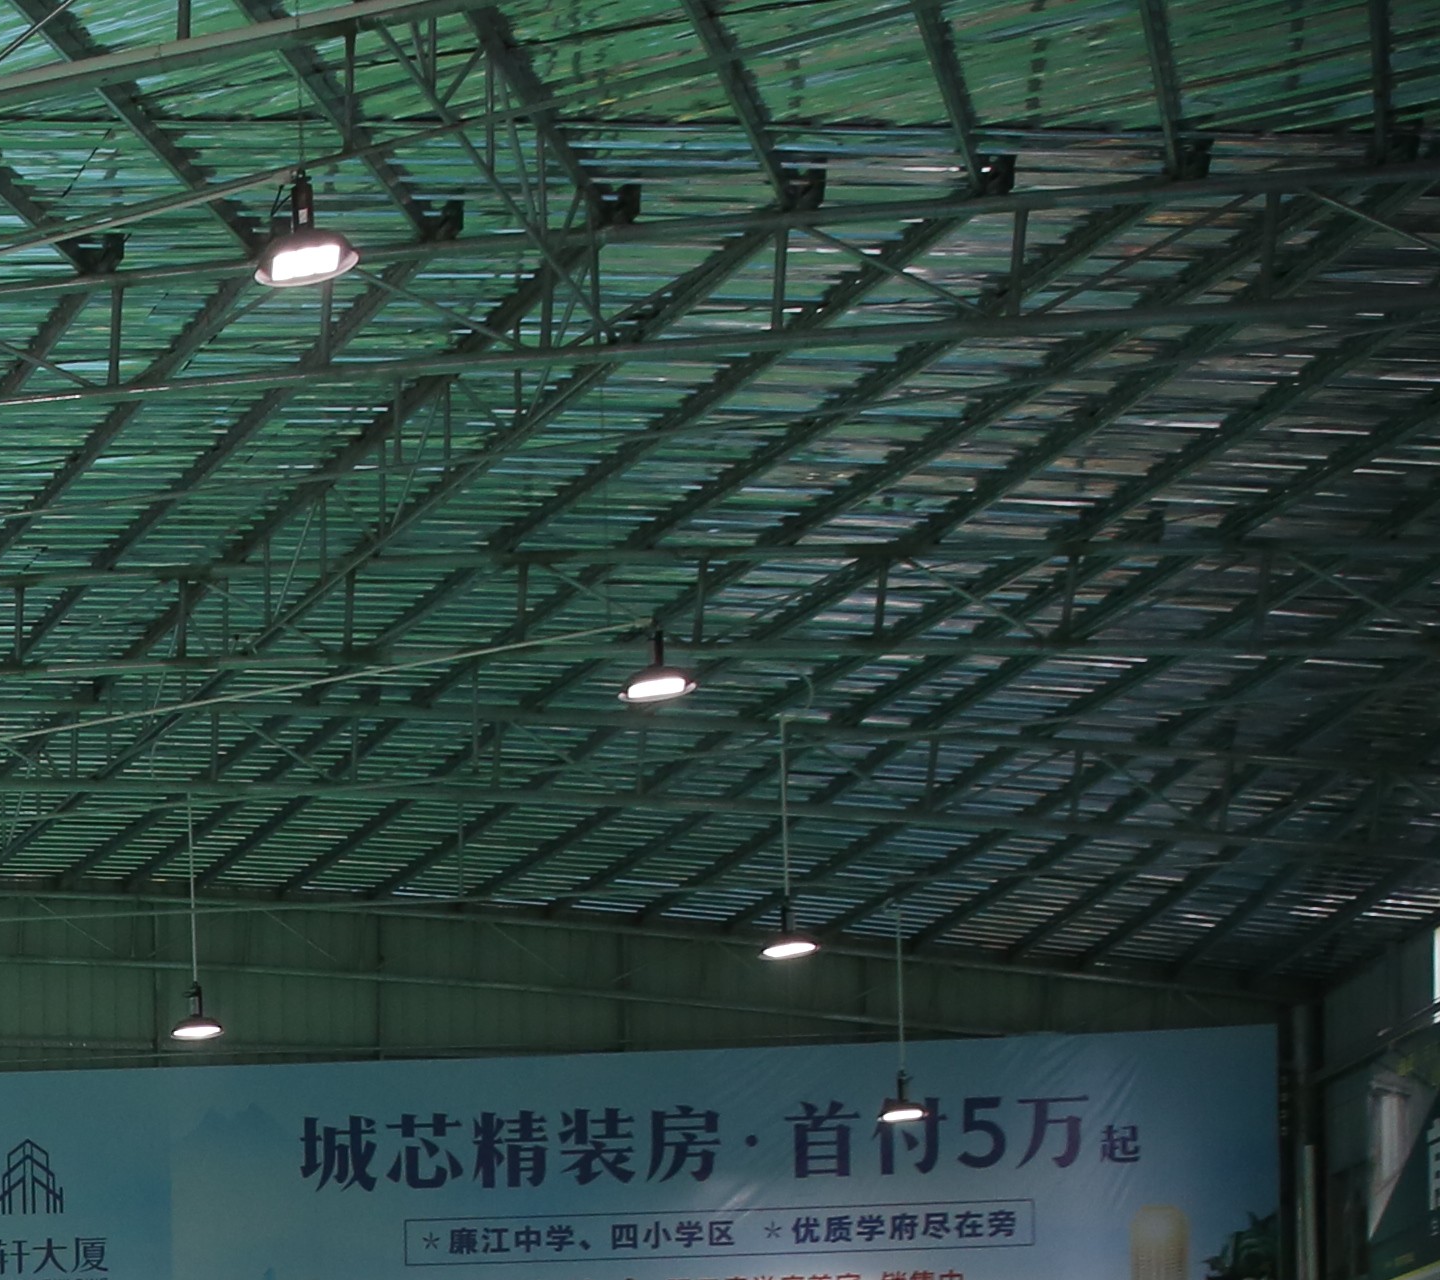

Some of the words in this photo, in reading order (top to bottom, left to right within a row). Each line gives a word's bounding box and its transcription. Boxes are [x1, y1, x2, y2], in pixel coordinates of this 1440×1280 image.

[791, 1208, 1017, 1245] 优质学府尽在旁
